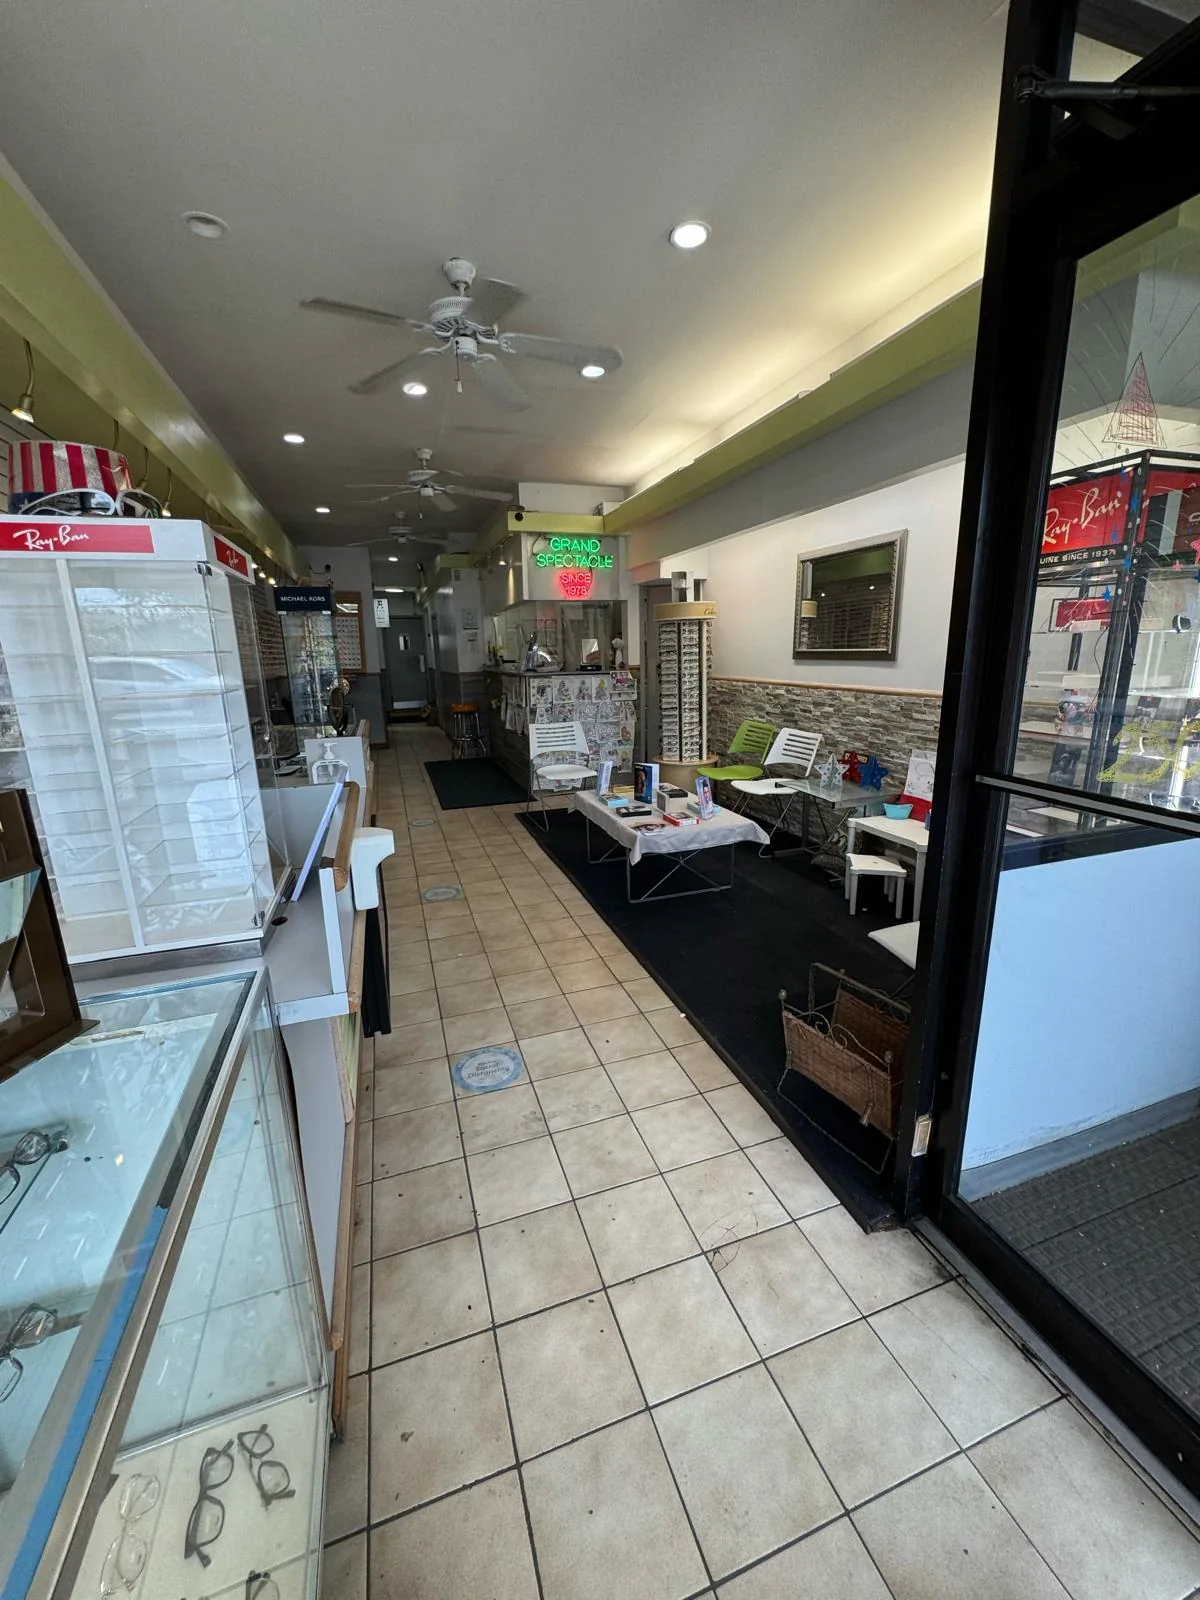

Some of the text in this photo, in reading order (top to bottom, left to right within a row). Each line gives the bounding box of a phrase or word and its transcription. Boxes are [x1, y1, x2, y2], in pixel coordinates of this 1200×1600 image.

[1042, 487, 1121, 546] Ray-Ban
[13, 525, 89, 551] Ray-Ban
[550, 537, 601, 552] GRAND
[536, 553, 614, 568] SPECTACLE
[1062, 552, 1089, 561] SINCE
[561, 573, 591, 584] SINCE
[566, 586, 587, 595] 1978
